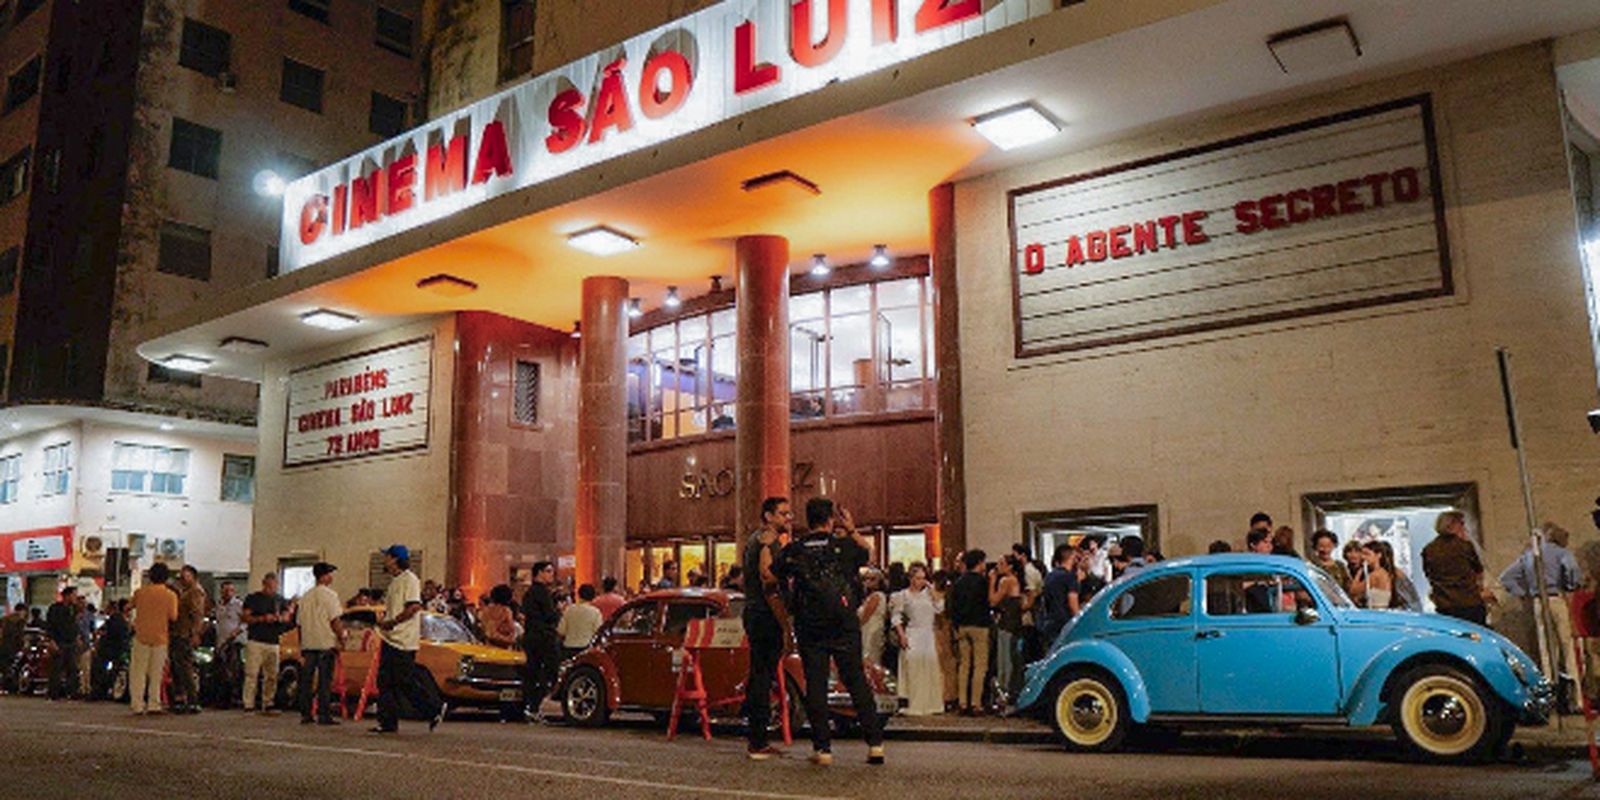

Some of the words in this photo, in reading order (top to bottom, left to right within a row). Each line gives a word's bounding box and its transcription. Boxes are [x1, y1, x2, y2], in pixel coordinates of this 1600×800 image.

[299, 120, 513, 245] CINEMA
[545, 50, 691, 153] SÃO
[1024, 243, 1045, 275] O
[1066, 210, 1210, 267] AGENTE
[1234, 166, 1420, 235] SECRETO
